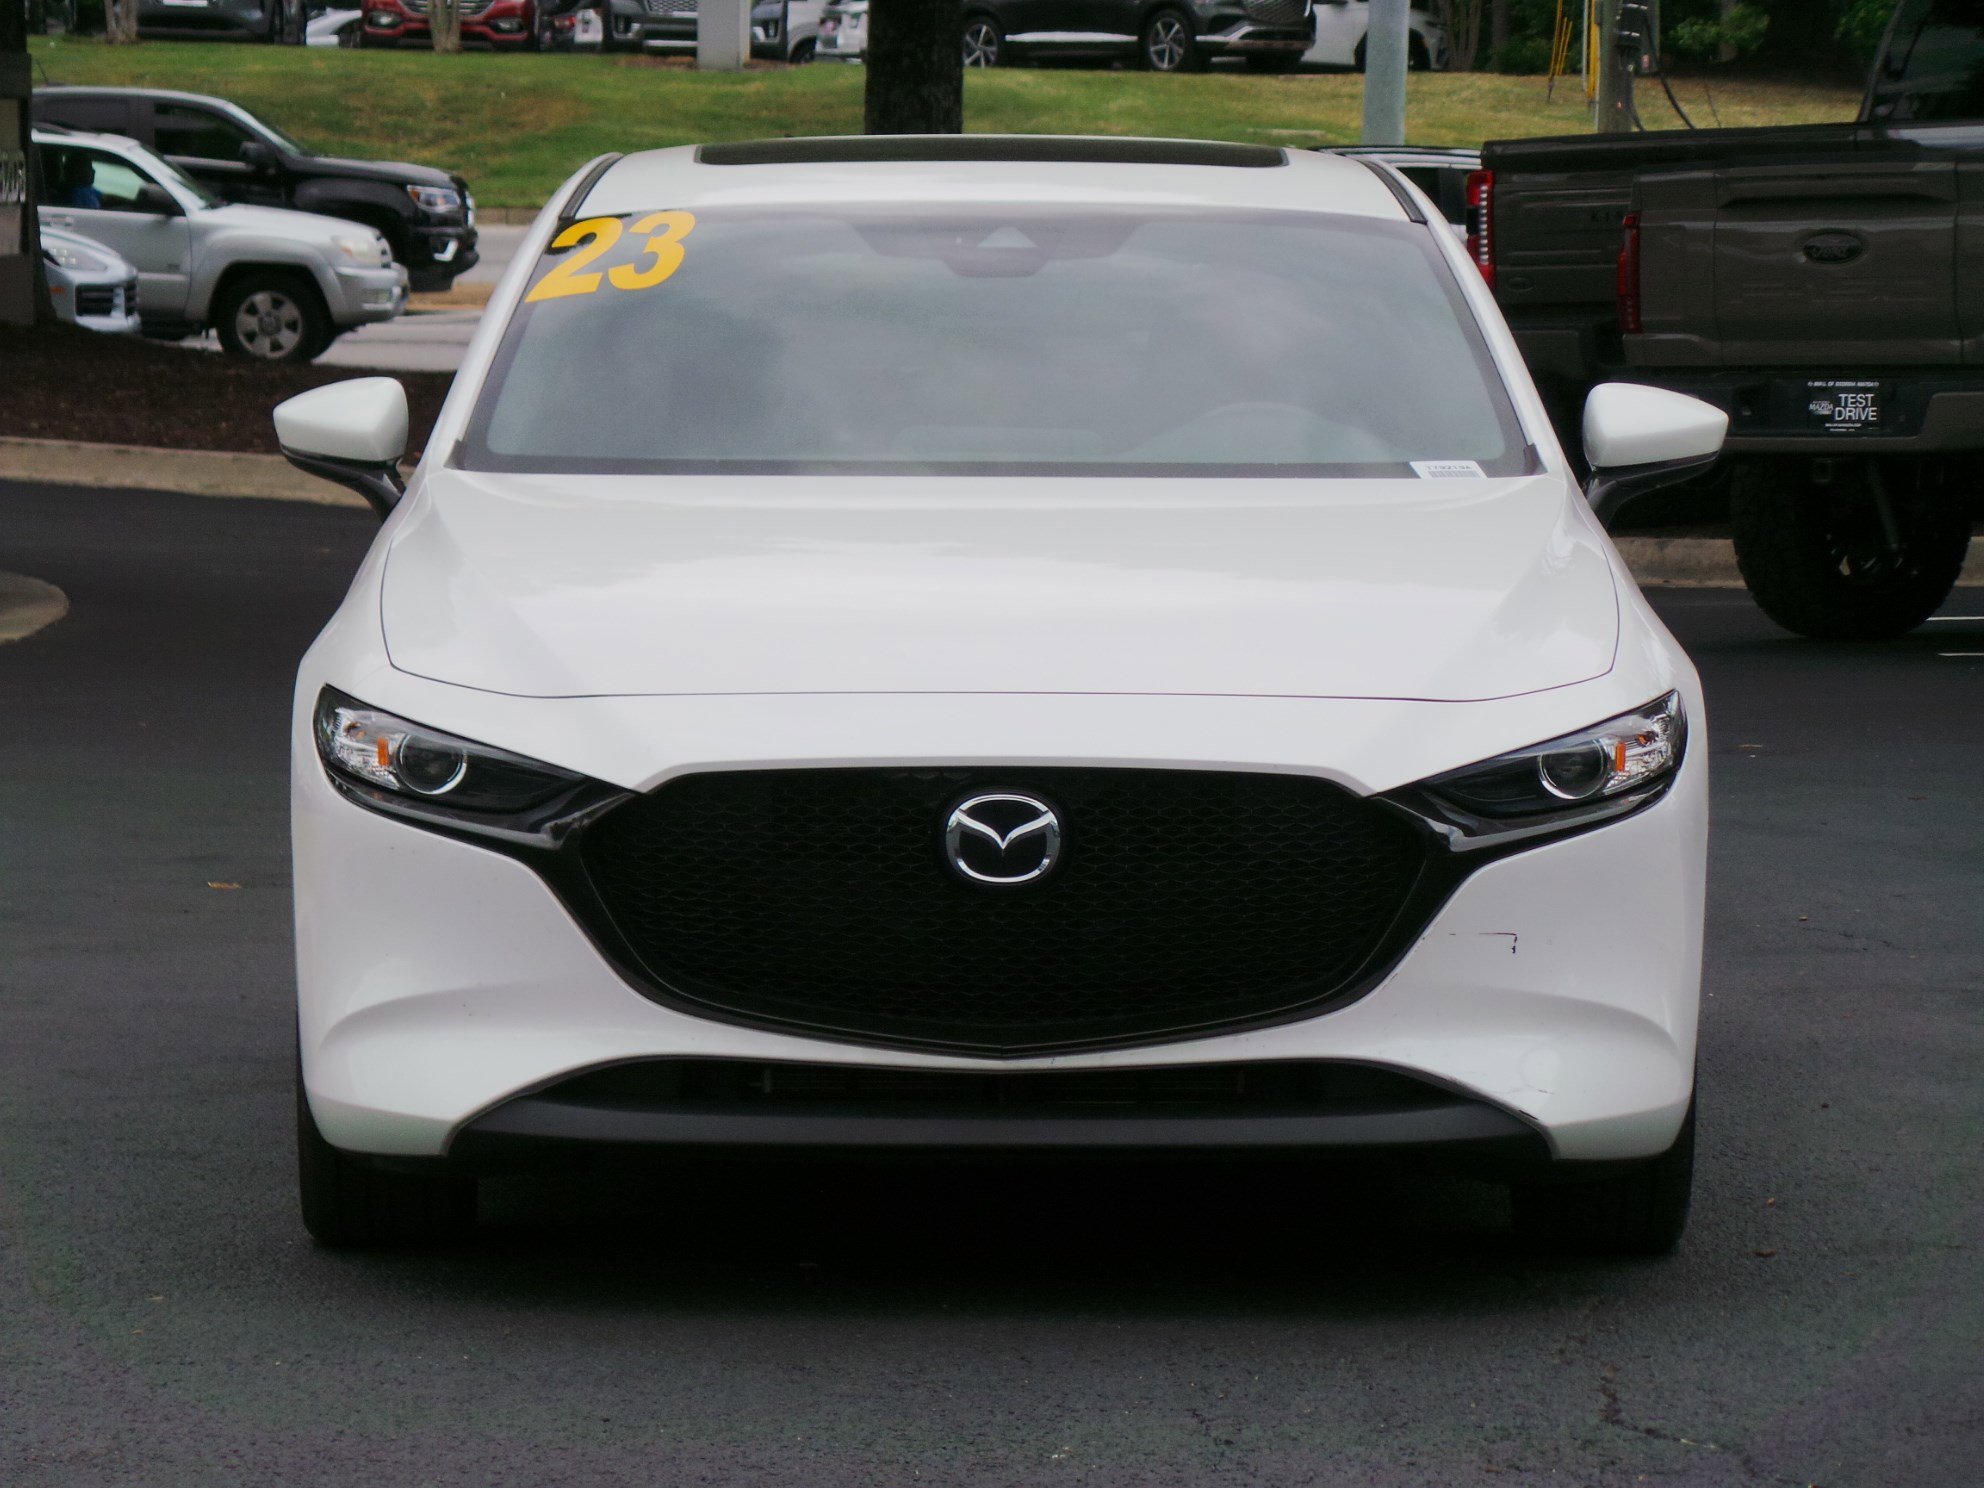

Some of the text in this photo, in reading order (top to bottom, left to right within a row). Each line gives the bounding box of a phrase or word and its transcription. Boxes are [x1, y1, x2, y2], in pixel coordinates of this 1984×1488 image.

[525, 211, 696, 303] 23
[1808, 403, 1834, 411] MAZDA
[1838, 393, 1875, 407] TEST
[1835, 407, 1878, 421] DRIVE
